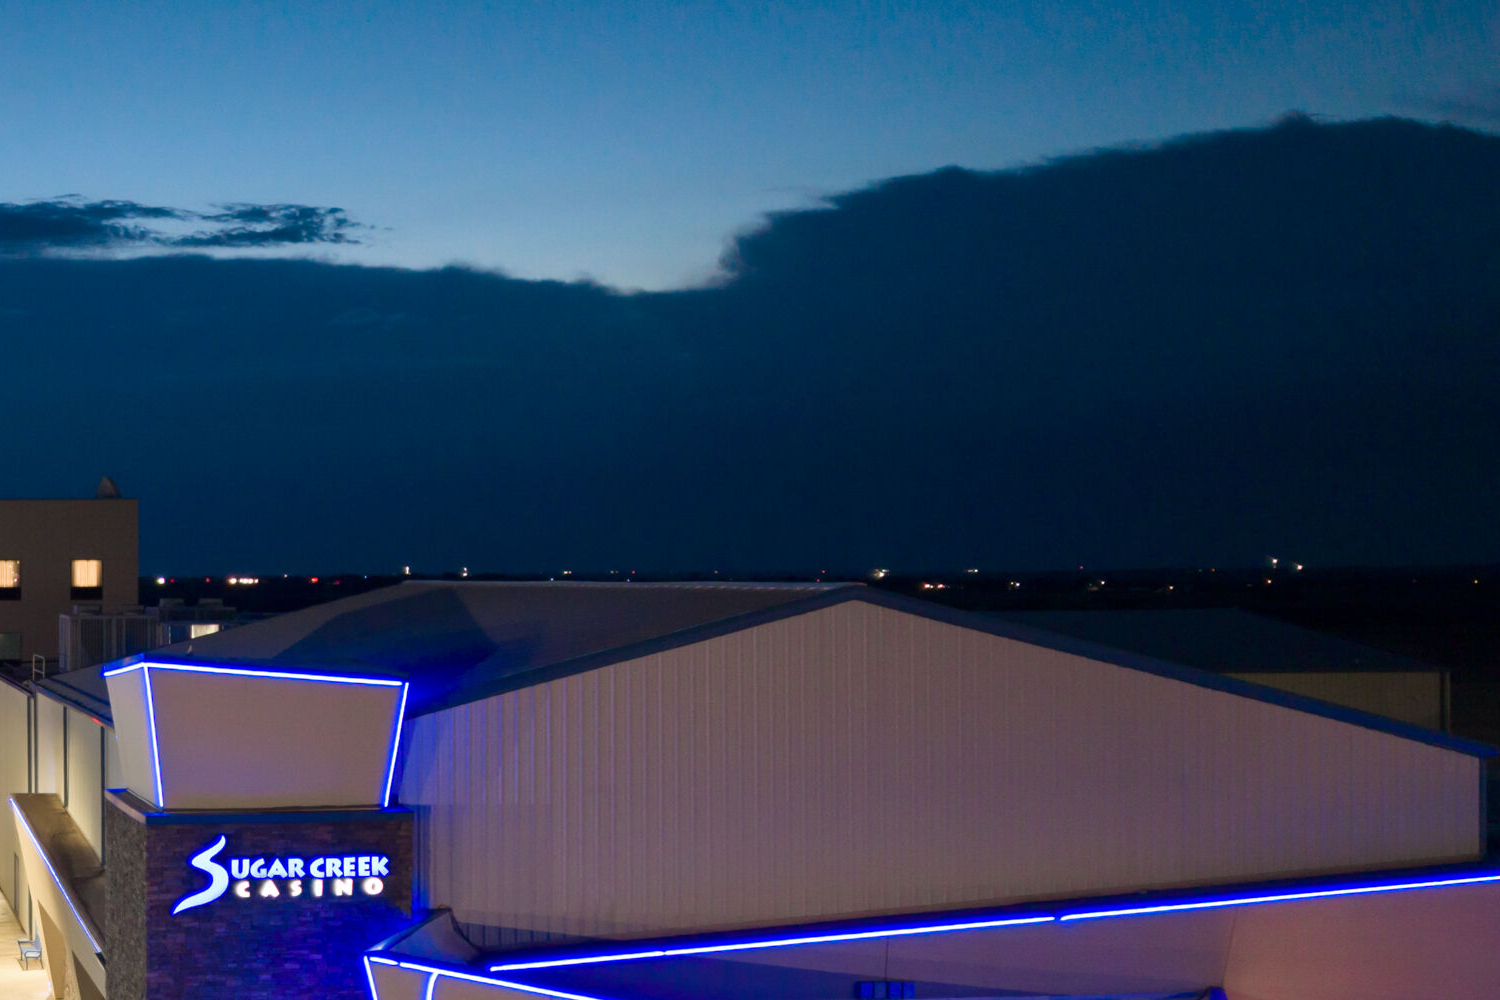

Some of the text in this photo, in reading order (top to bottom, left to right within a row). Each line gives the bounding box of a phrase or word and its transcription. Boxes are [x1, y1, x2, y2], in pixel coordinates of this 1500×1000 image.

[172, 834, 390, 915] SUGAR CREEK
[233, 877, 384, 898] CASINO
